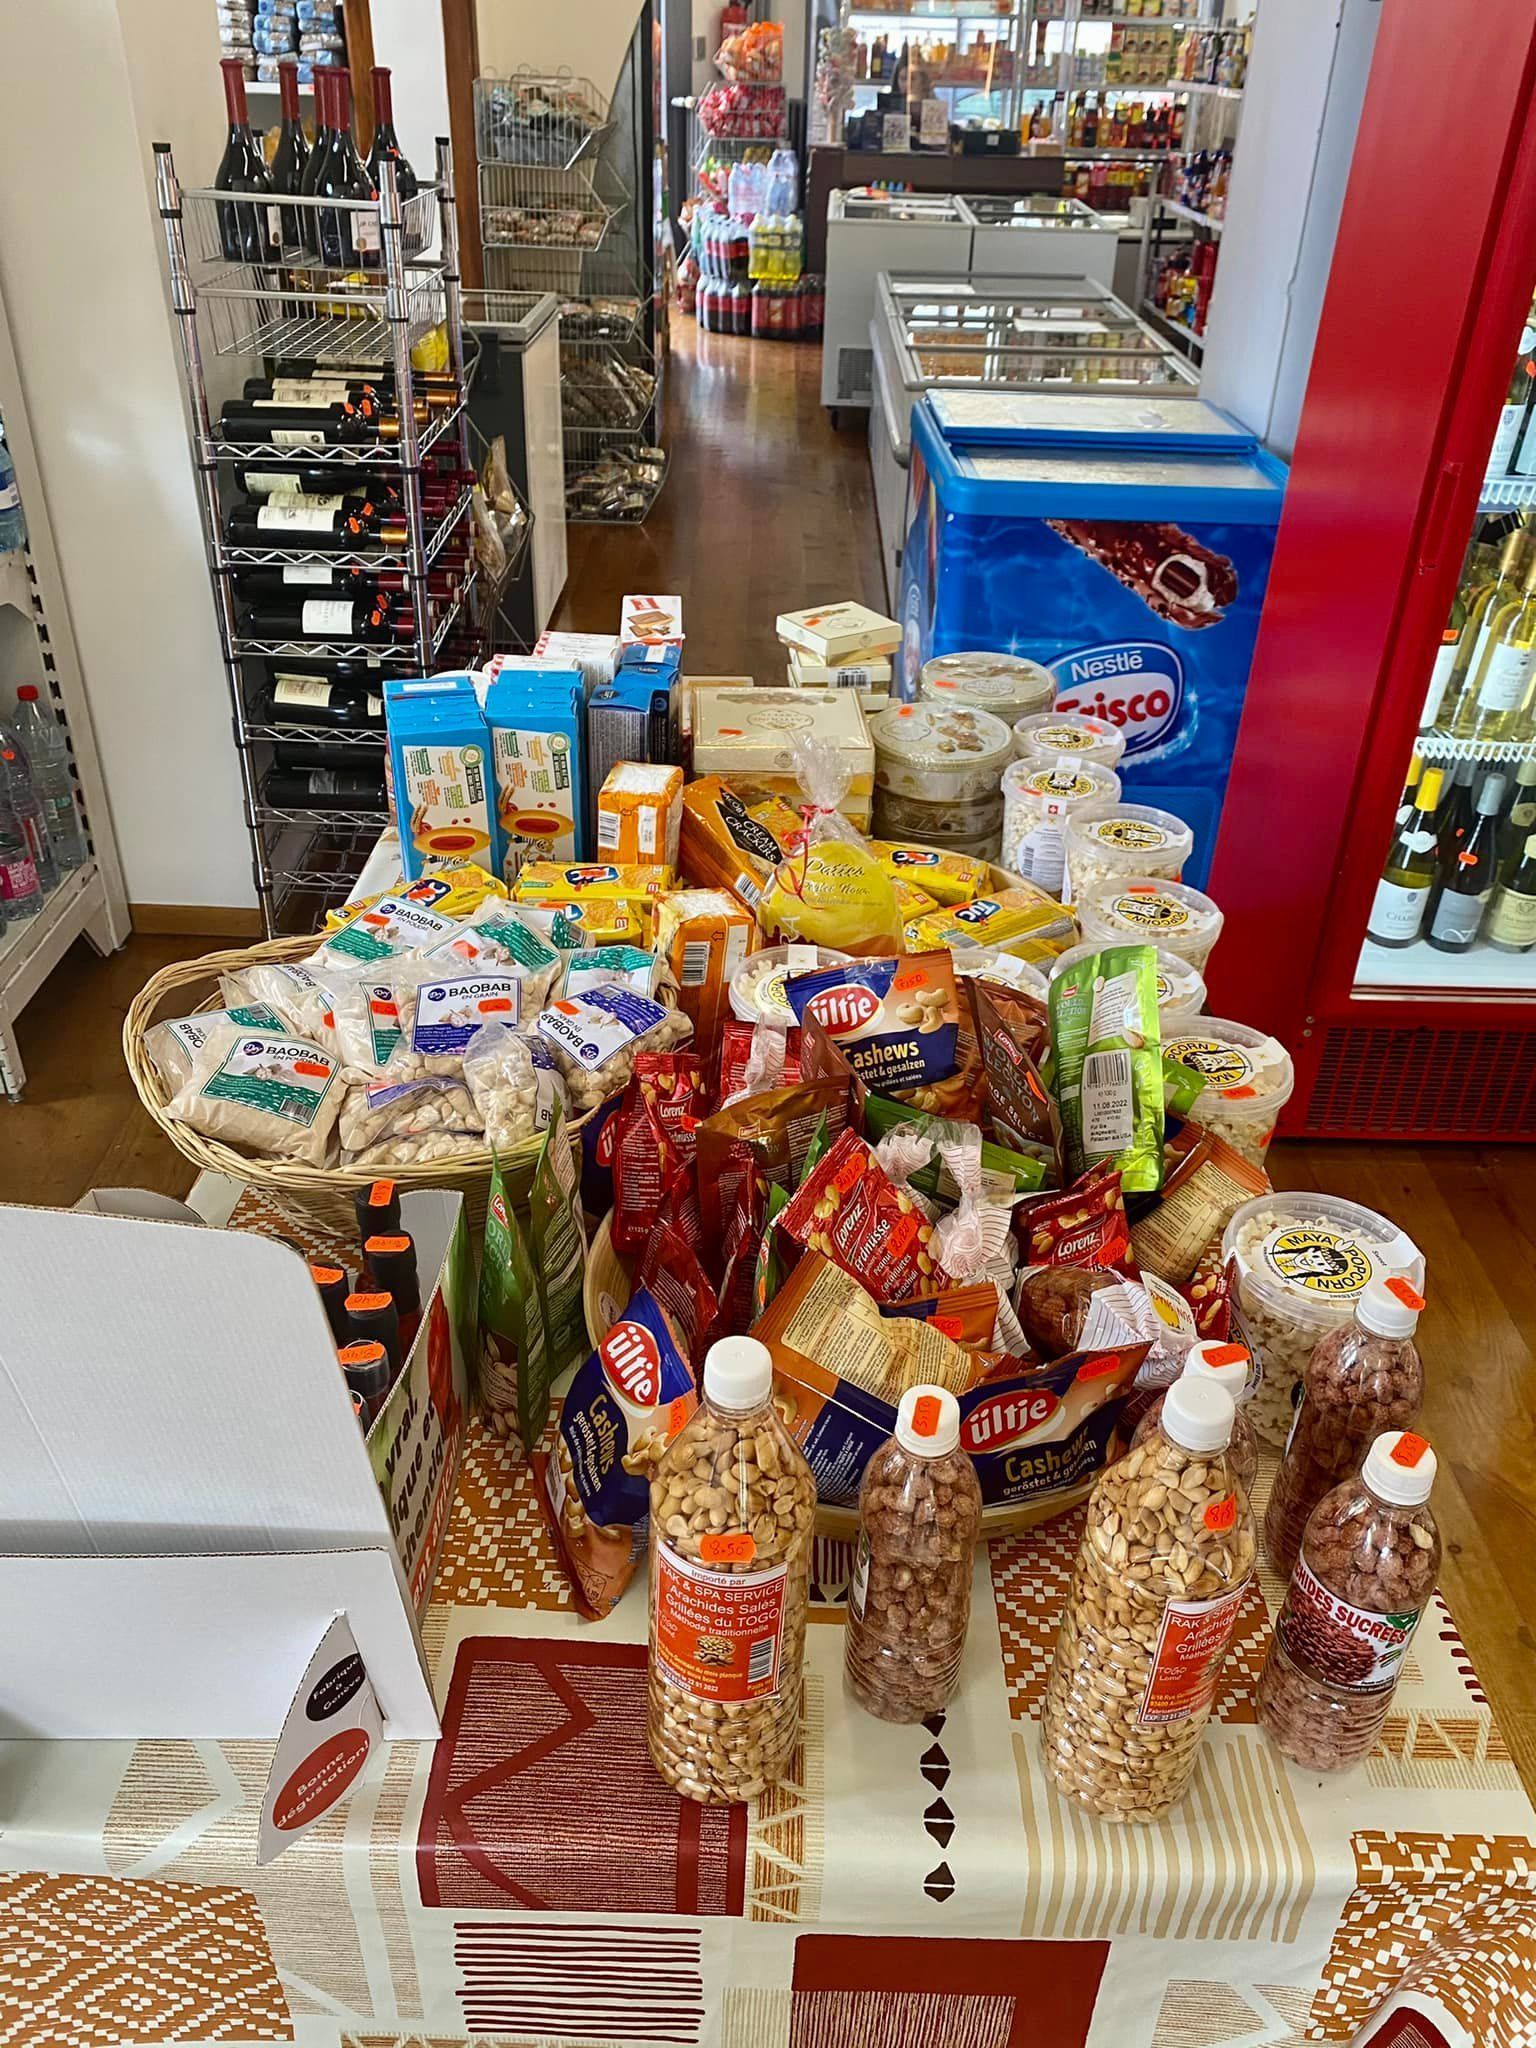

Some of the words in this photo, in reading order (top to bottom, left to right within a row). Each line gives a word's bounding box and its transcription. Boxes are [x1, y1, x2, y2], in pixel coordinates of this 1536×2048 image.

[1071, 650, 1143, 681] Nestlé
[725, 816, 777, 861] CRACKERS
[743, 820, 778, 852] CREAM
[395, 908, 443, 931] BAOBAB
[449, 983, 512, 998] BAOBAB
[812, 992, 874, 1027] ültje
[541, 1013, 584, 1048] BAOBAB
[265, 1046, 330, 1067] BAOBAB
[887, 1060, 926, 1079] gesalzen
[660, 1103, 687, 1118] Lorenz
[836, 1202, 867, 1250] Lorenz
[1287, 1233, 1333, 1247] MAYA
[855, 1218, 891, 1273] Erdnüsse
[1057, 1230, 1101, 1258] Lorenz
[1317, 1248, 1367, 1290] POPCORN
[606, 1325, 654, 1403] ültje
[588, 1393, 619, 1476] Cashews
[969, 1398, 1048, 1445] ültje
[1003, 1476, 1051, 1496] geröstet
[660, 1562, 680, 1585] RAK
[682, 1581, 692, 1592] &
[694, 1585, 721, 1601] SPA
[723, 1580, 784, 1602] SERVICE
[691, 1569, 727, 1585] Importé
[728, 1578, 747, 1587] par
[665, 1593, 711, 1625] Grillées
[714, 1617, 732, 1628] du
[735, 1607, 780, 1628] TOGO
[670, 1585, 735, 1615] Arachides
[738, 1598, 776, 1615] Salés
[670, 1608, 706, 1633] Méthode
[708, 1624, 769, 1637] traditionnelle
[1170, 1616, 1201, 1630] RAK
[1184, 1613, 1238, 1642] Arachide
[312, 1656, 361, 1701] Fabriqué
[335, 1682, 344, 1691] à
[1157, 1666, 1188, 1676] TOGO
[322, 1675, 362, 1711] Genève
[276, 1738, 370, 1829] dégustation!
[296, 1751, 346, 1798] Bonne
